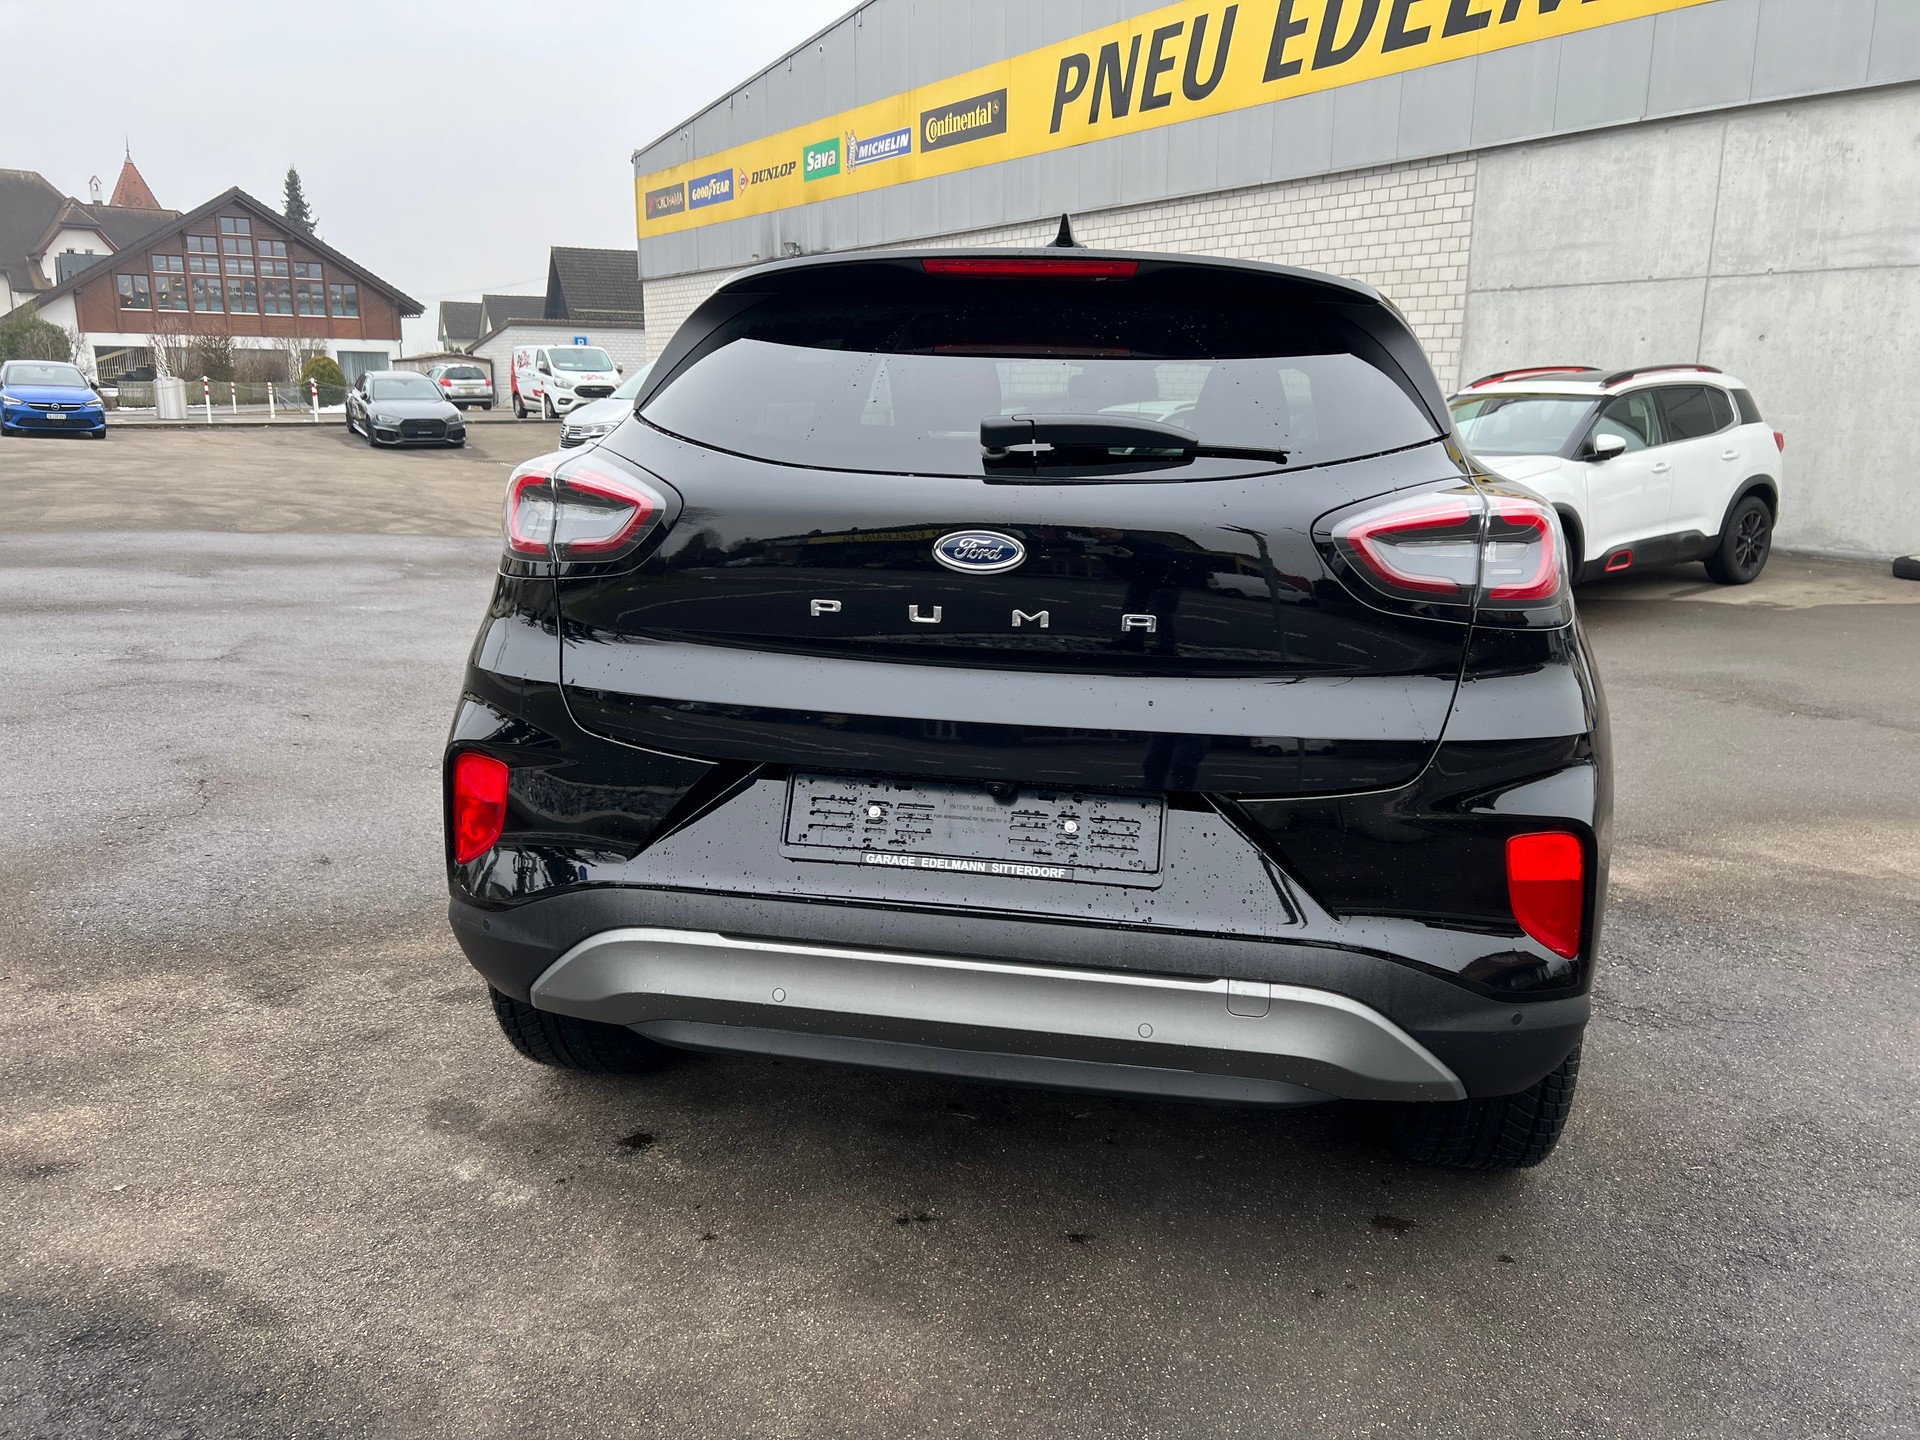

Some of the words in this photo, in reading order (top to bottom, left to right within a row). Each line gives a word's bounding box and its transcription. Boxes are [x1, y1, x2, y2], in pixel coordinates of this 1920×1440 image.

[1049, 3, 1239, 134] PNEU
[1262, 0, 1600, 83] EDE
[926, 101, 992, 144] Continental
[858, 133, 910, 159] MICHELIN
[751, 161, 796, 185] DUNLOP
[806, 149, 836, 172] Sava
[692, 178, 730, 201] GOODYEAR
[953, 537, 1003, 561] Ford
[810, 598, 1157, 632] PUMA
[949, 803, 970, 812] PATENT
[866, 853, 916, 867] GARAGE
[921, 857, 986, 872] EDELMANN
[991, 863, 1066, 879] SITTERDORF
